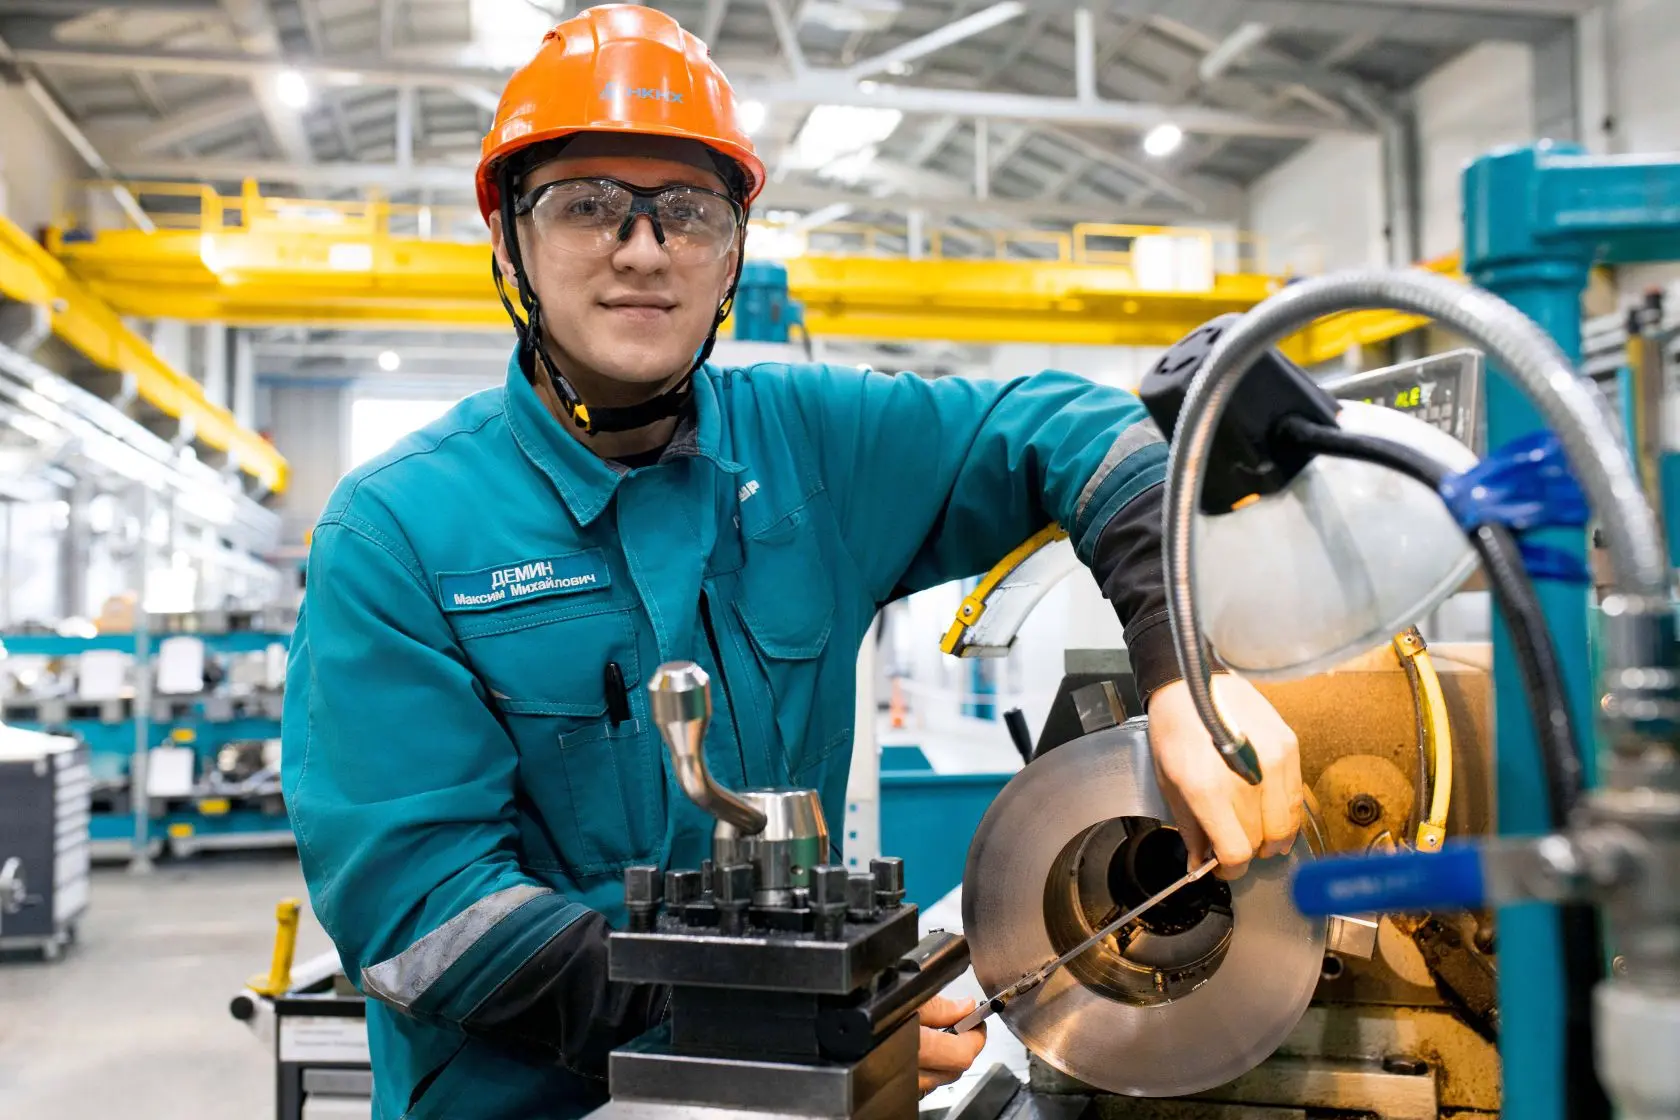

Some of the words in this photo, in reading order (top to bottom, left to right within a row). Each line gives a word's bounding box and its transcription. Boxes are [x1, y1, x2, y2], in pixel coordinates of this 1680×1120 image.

[626, 87, 684, 104] НКНХ
[454, 589, 506, 605] Максим
[510, 573, 596, 597] Михайлович
[491, 561, 554, 590] ДЕМИН
